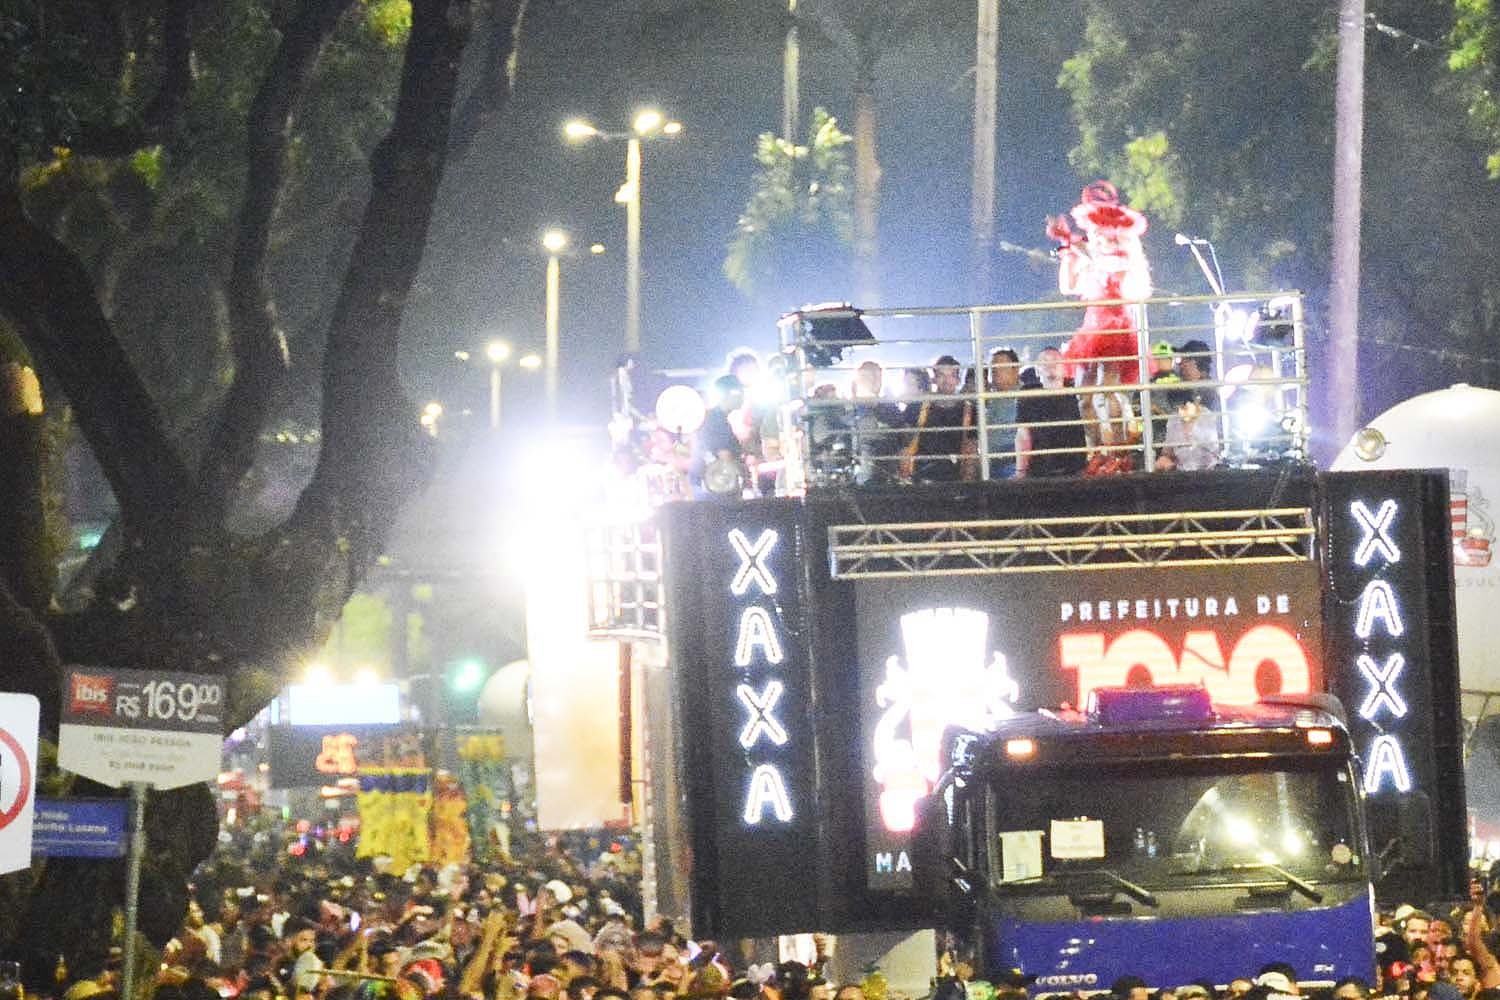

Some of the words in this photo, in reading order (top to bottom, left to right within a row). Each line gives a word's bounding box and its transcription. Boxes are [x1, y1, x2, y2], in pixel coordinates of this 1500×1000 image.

[1060, 597, 1239, 622] PREFEITURA
[1256, 595, 1290, 615] DE
[76, 683, 108, 701] ibis
